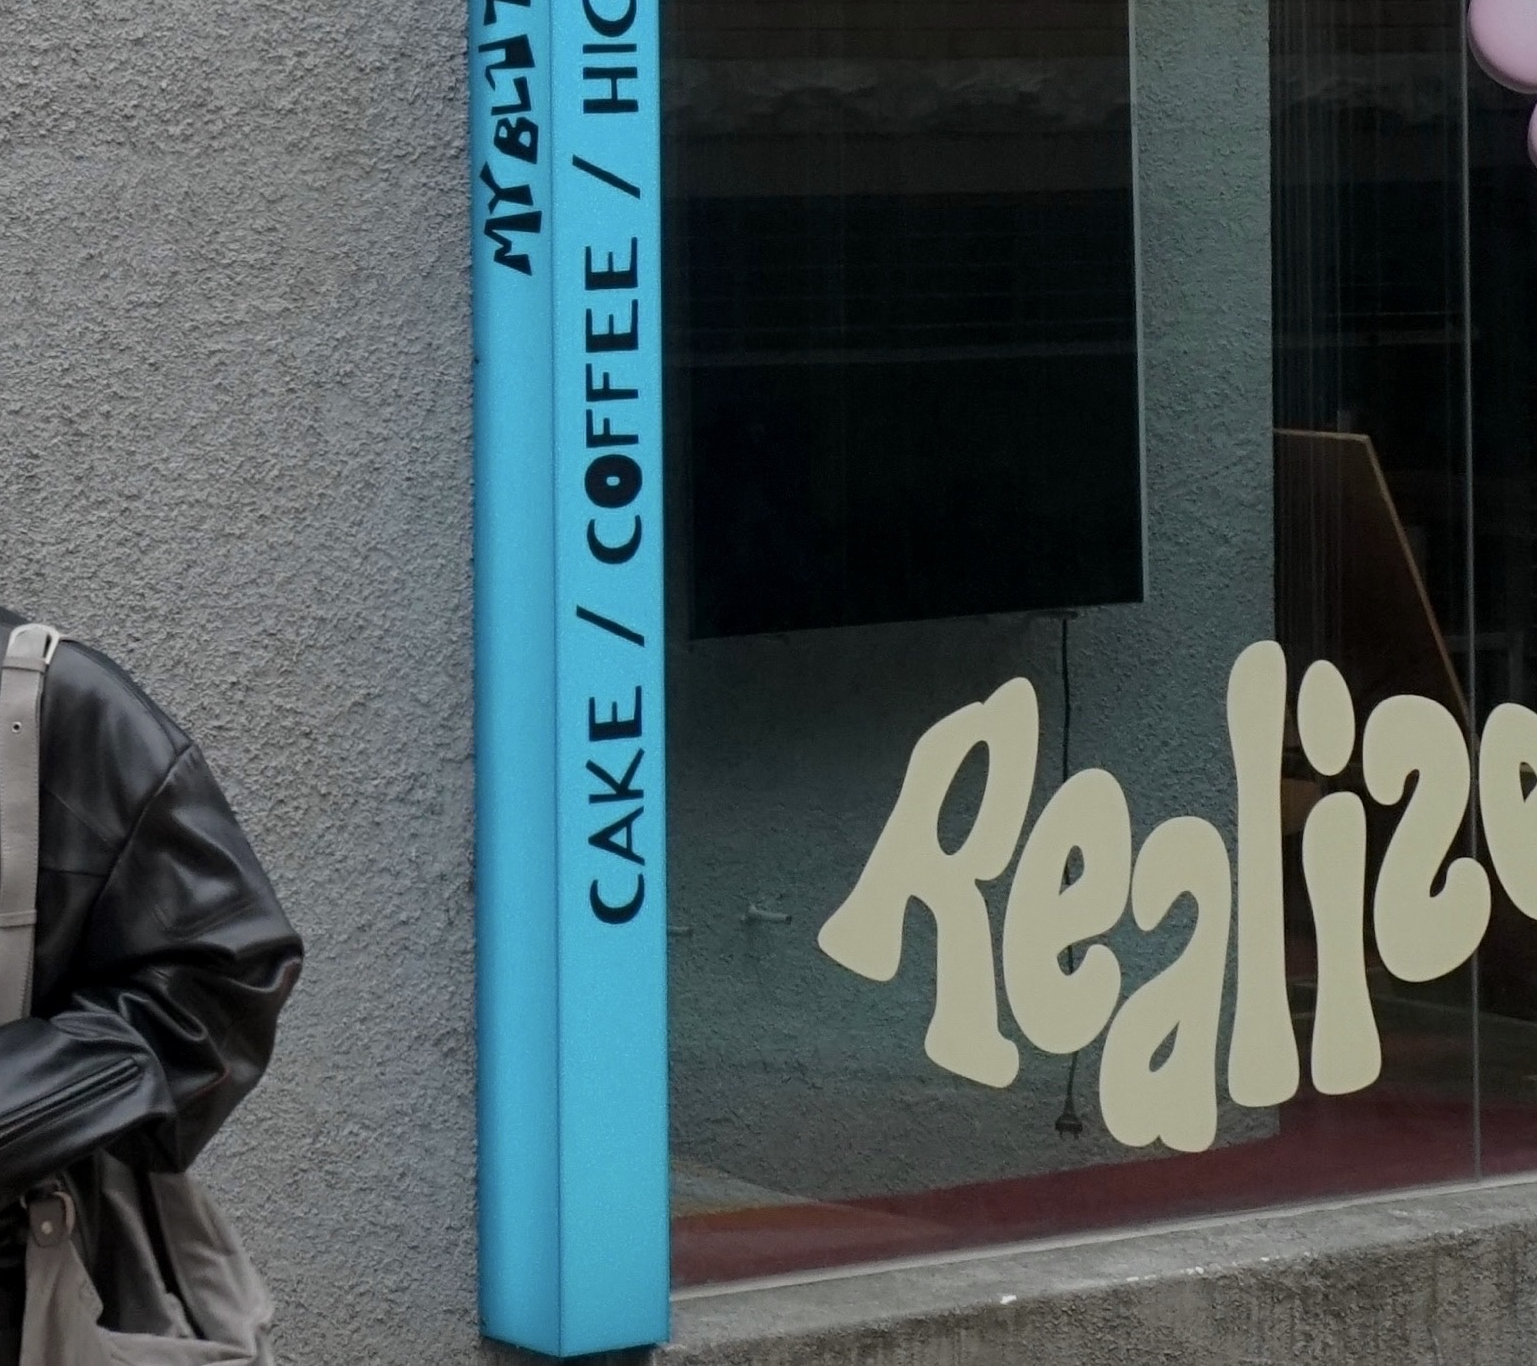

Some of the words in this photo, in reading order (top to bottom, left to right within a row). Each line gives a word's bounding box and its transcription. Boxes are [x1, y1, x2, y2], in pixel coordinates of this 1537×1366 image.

[479, 162, 542, 276] MY
[584, 237, 643, 565] COFFEE
[585, 685, 645, 925] CAKE
